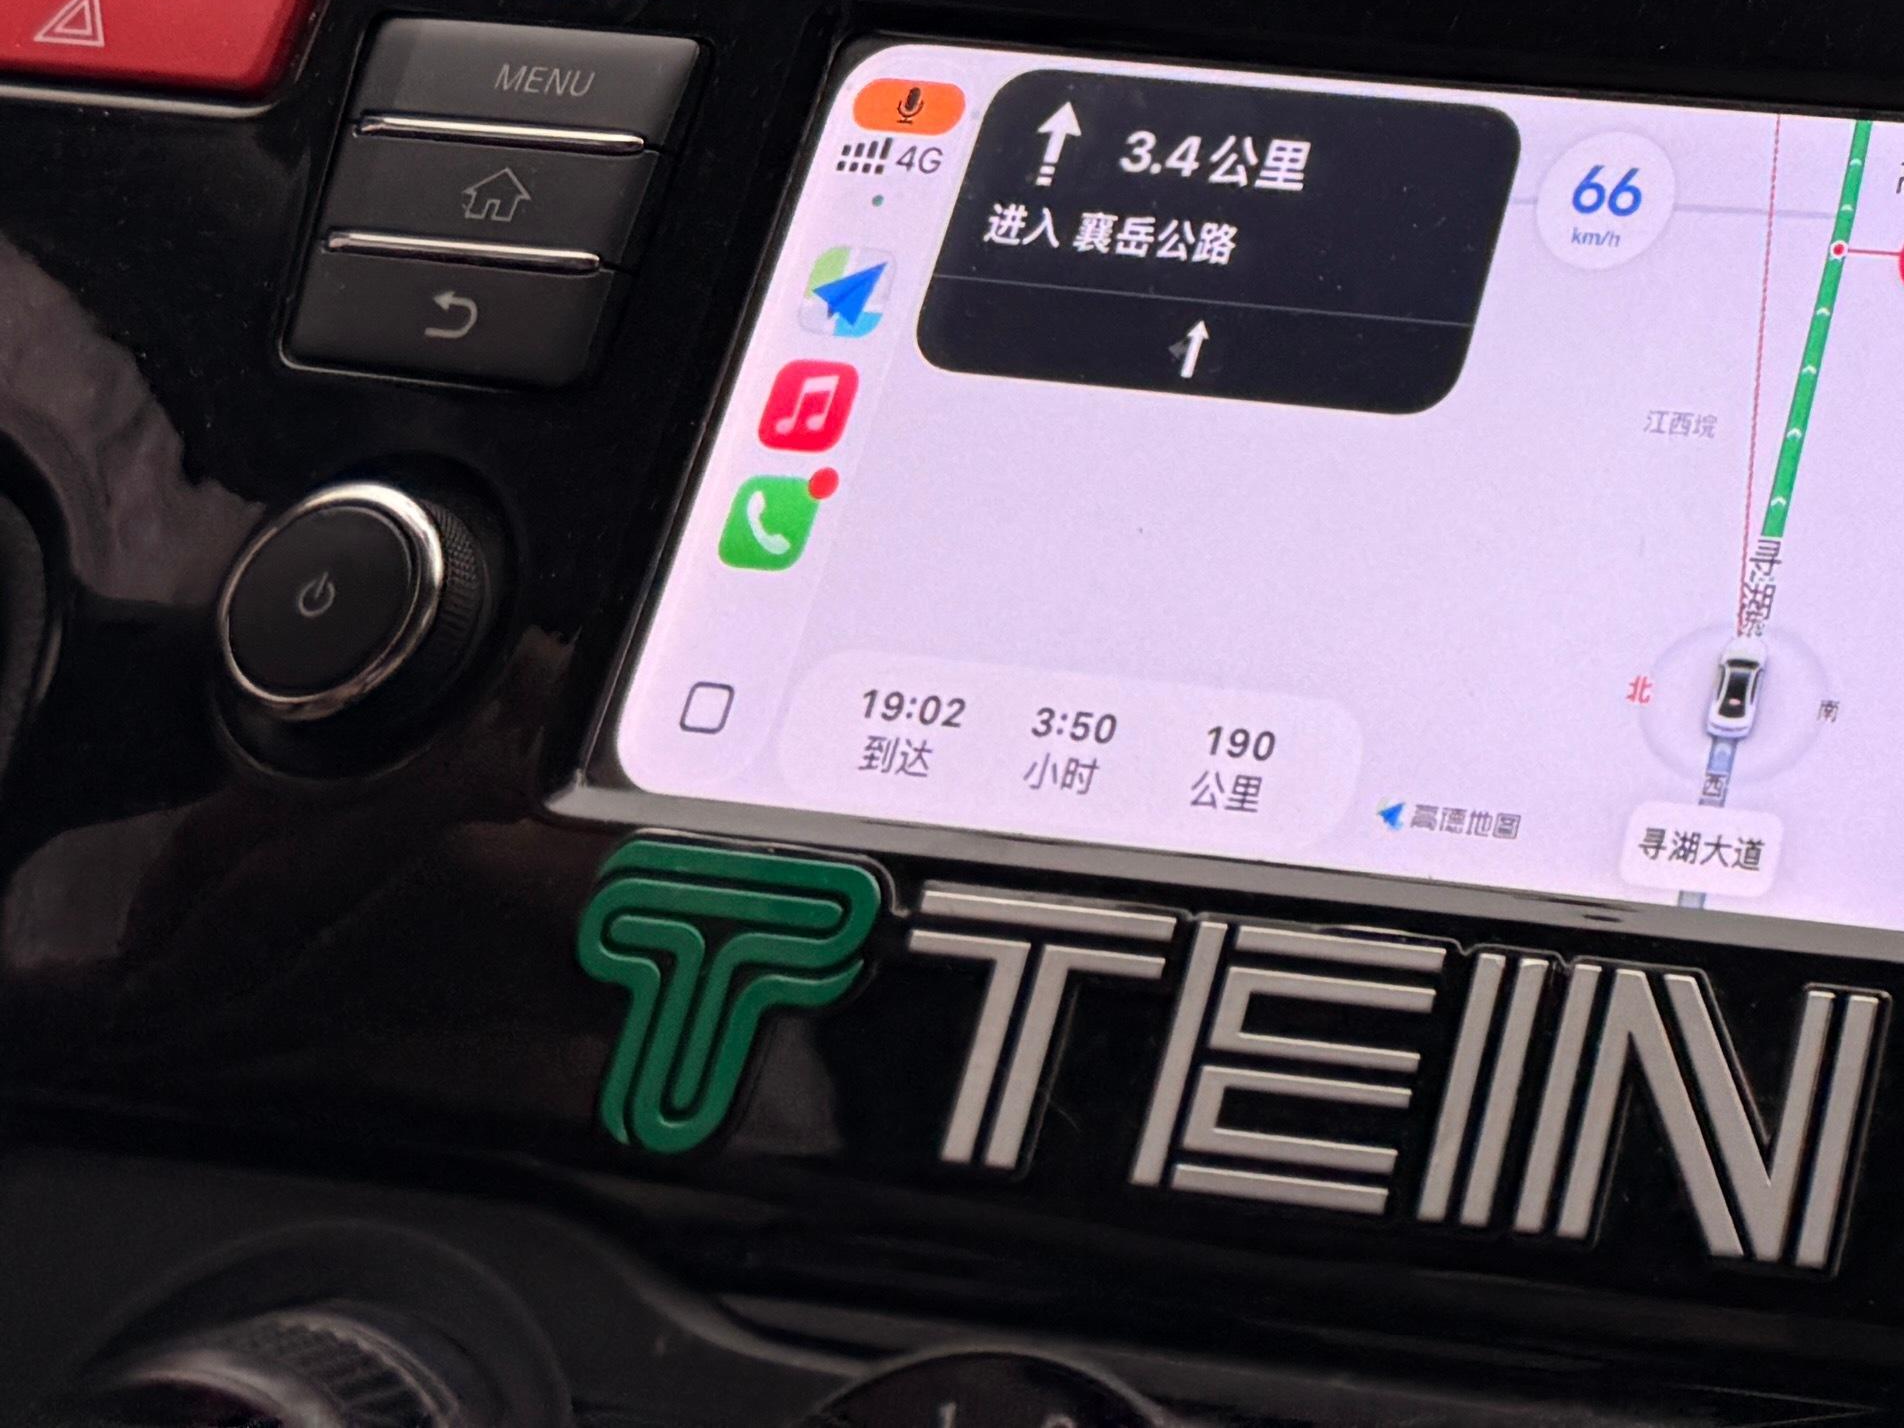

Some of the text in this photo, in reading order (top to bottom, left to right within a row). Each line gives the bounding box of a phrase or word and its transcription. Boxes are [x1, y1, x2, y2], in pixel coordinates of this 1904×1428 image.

[494, 61, 596, 99] MENU
[895, 144, 944, 176] 4G
[1571, 165, 1644, 218] 66
[983, 203, 1239, 266] 进入 襄岳公路
[1570, 226, 1622, 250] km/h
[861, 688, 967, 730] 19:02
[1626, 675, 1652, 705] 北
[1030, 706, 1118, 746] 3:50
[1815, 699, 1841, 724] 南
[857, 737, 934, 779] 到达
[1204, 725, 1277, 762] 190
[1023, 752, 1102, 797] 小时
[1189, 770, 1264, 814] 公里
[1701, 772, 1728, 799] 西
[1410, 803, 1522, 840] 高德地图
[1638, 826, 1767, 872] 寻湖大道
[908, 881, 1890, 1271] TEIN
